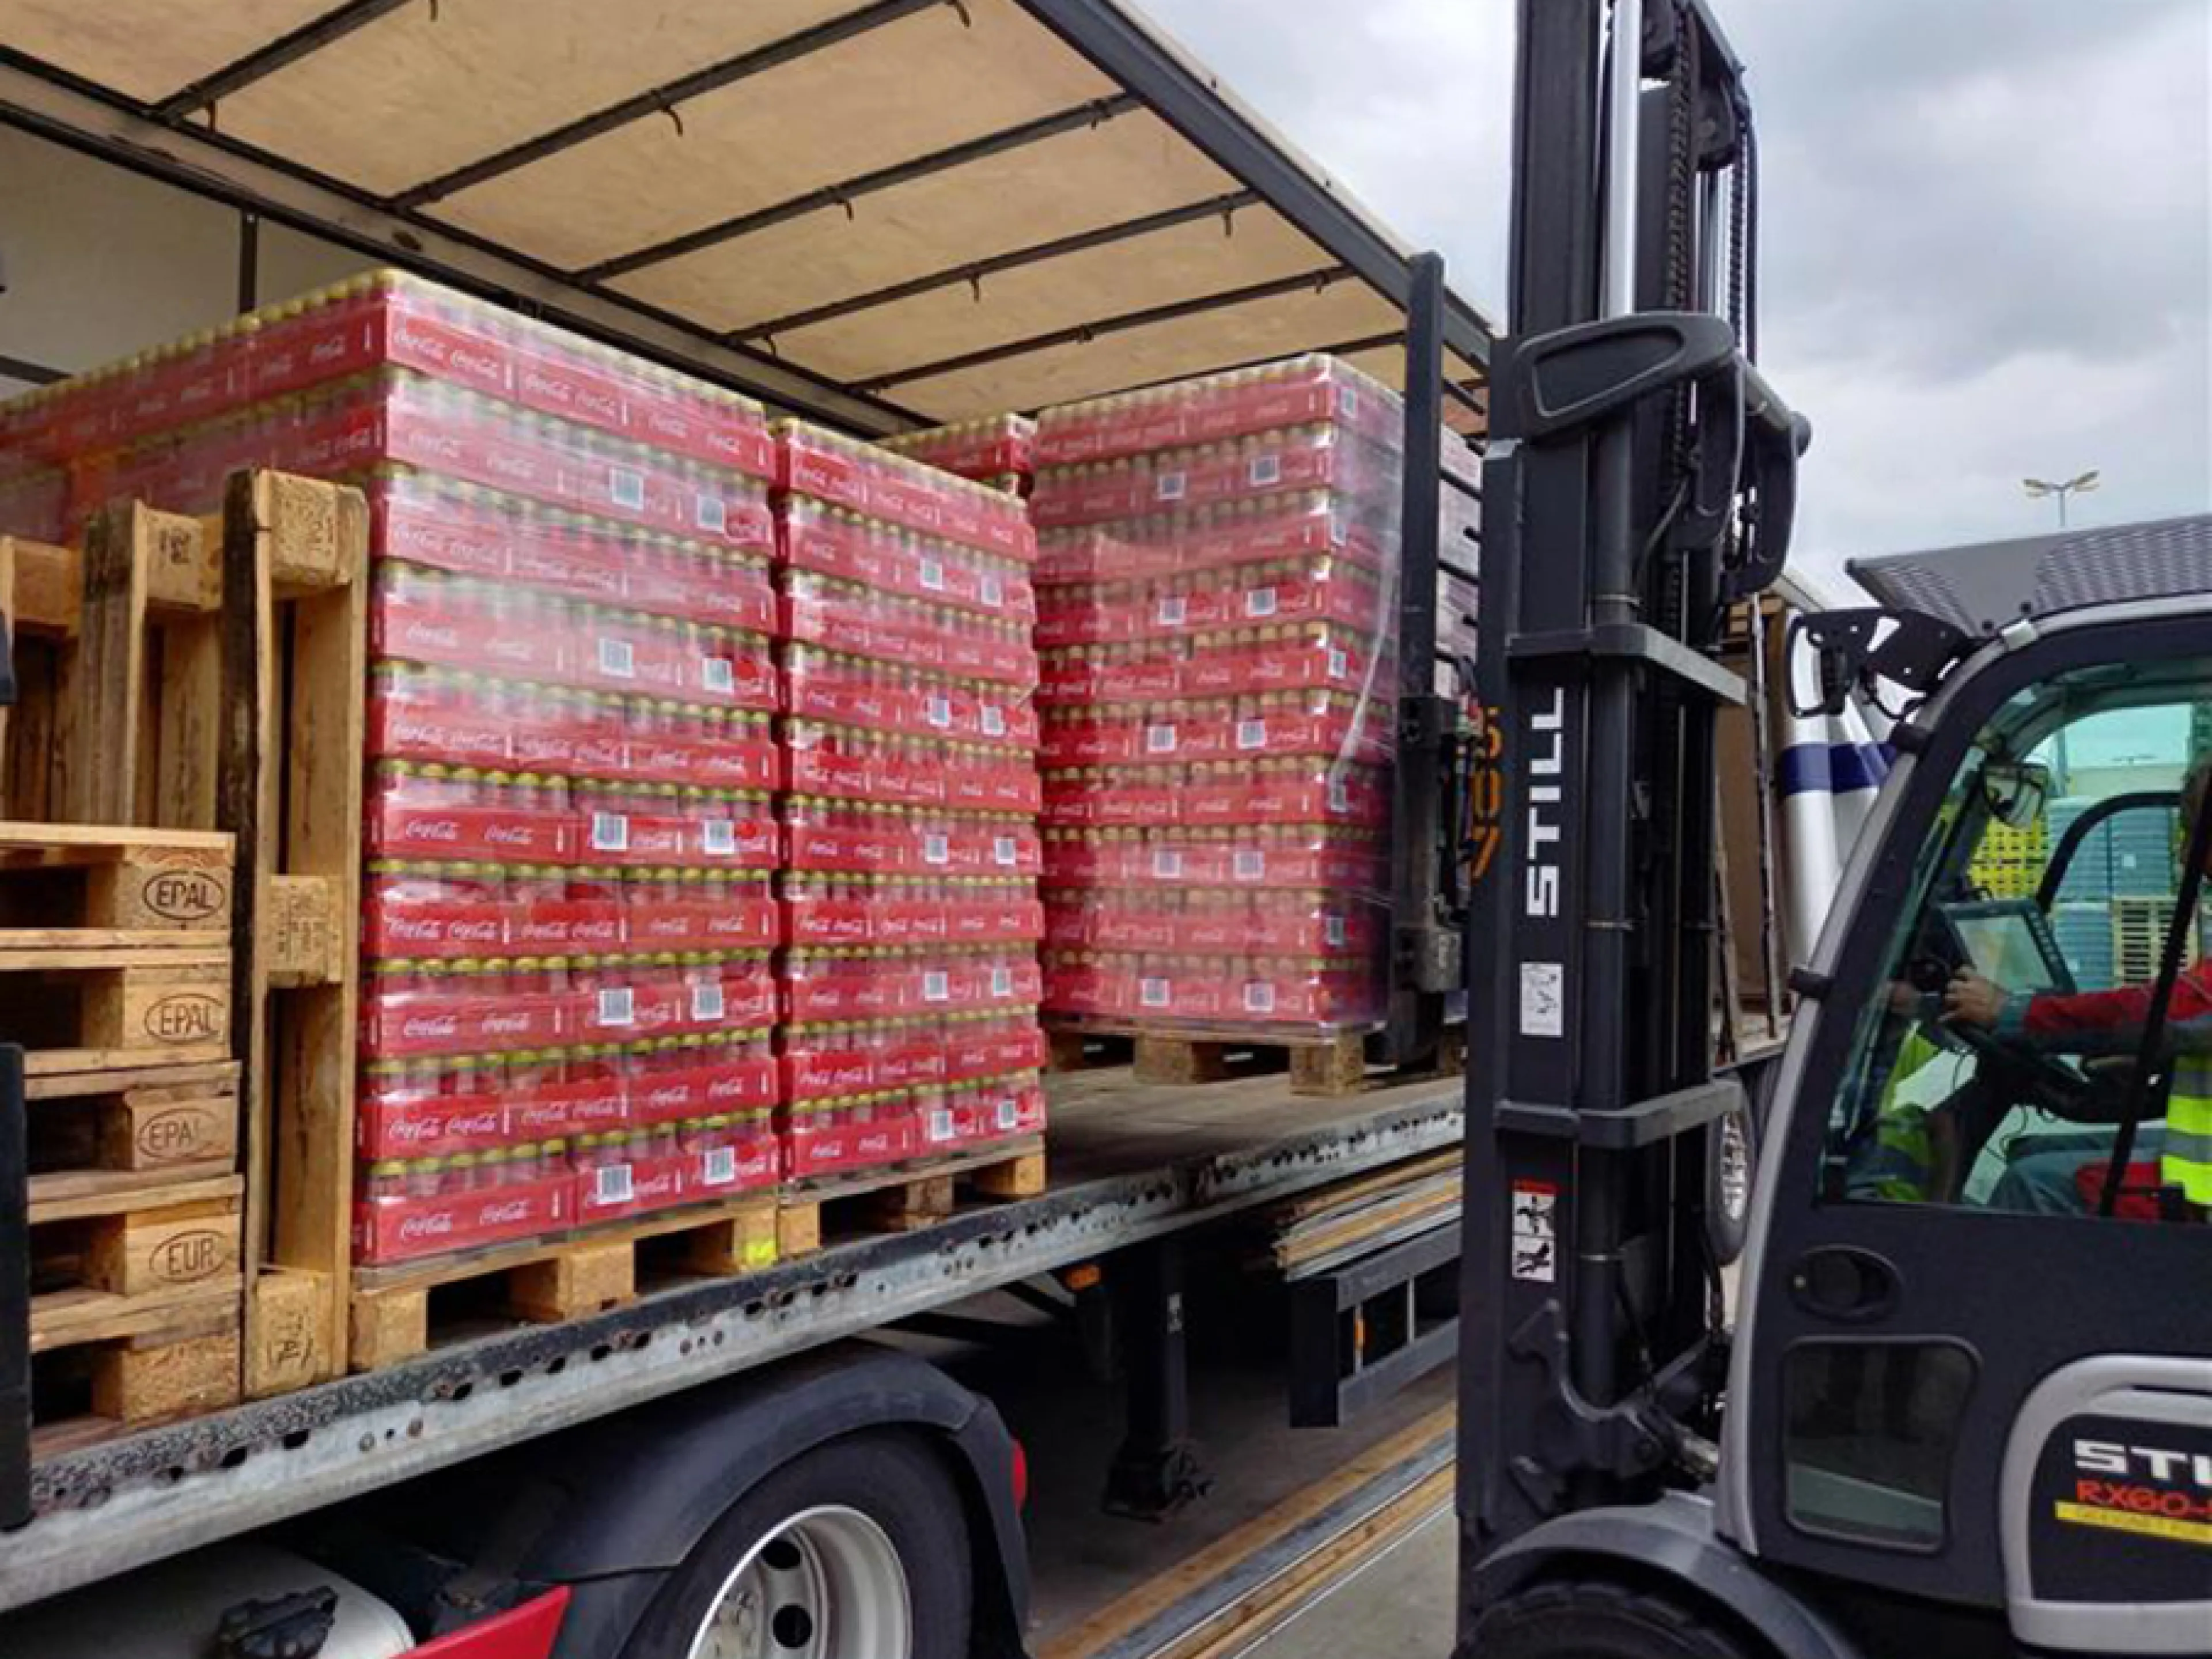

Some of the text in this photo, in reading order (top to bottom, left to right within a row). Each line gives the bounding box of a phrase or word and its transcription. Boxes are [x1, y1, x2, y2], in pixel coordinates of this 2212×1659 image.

[1527, 687, 1563, 916] STILL
[156, 880, 214, 909] EPAL
[160, 1002, 219, 1036] EPAL
[166, 1237, 217, 1275] EUR
